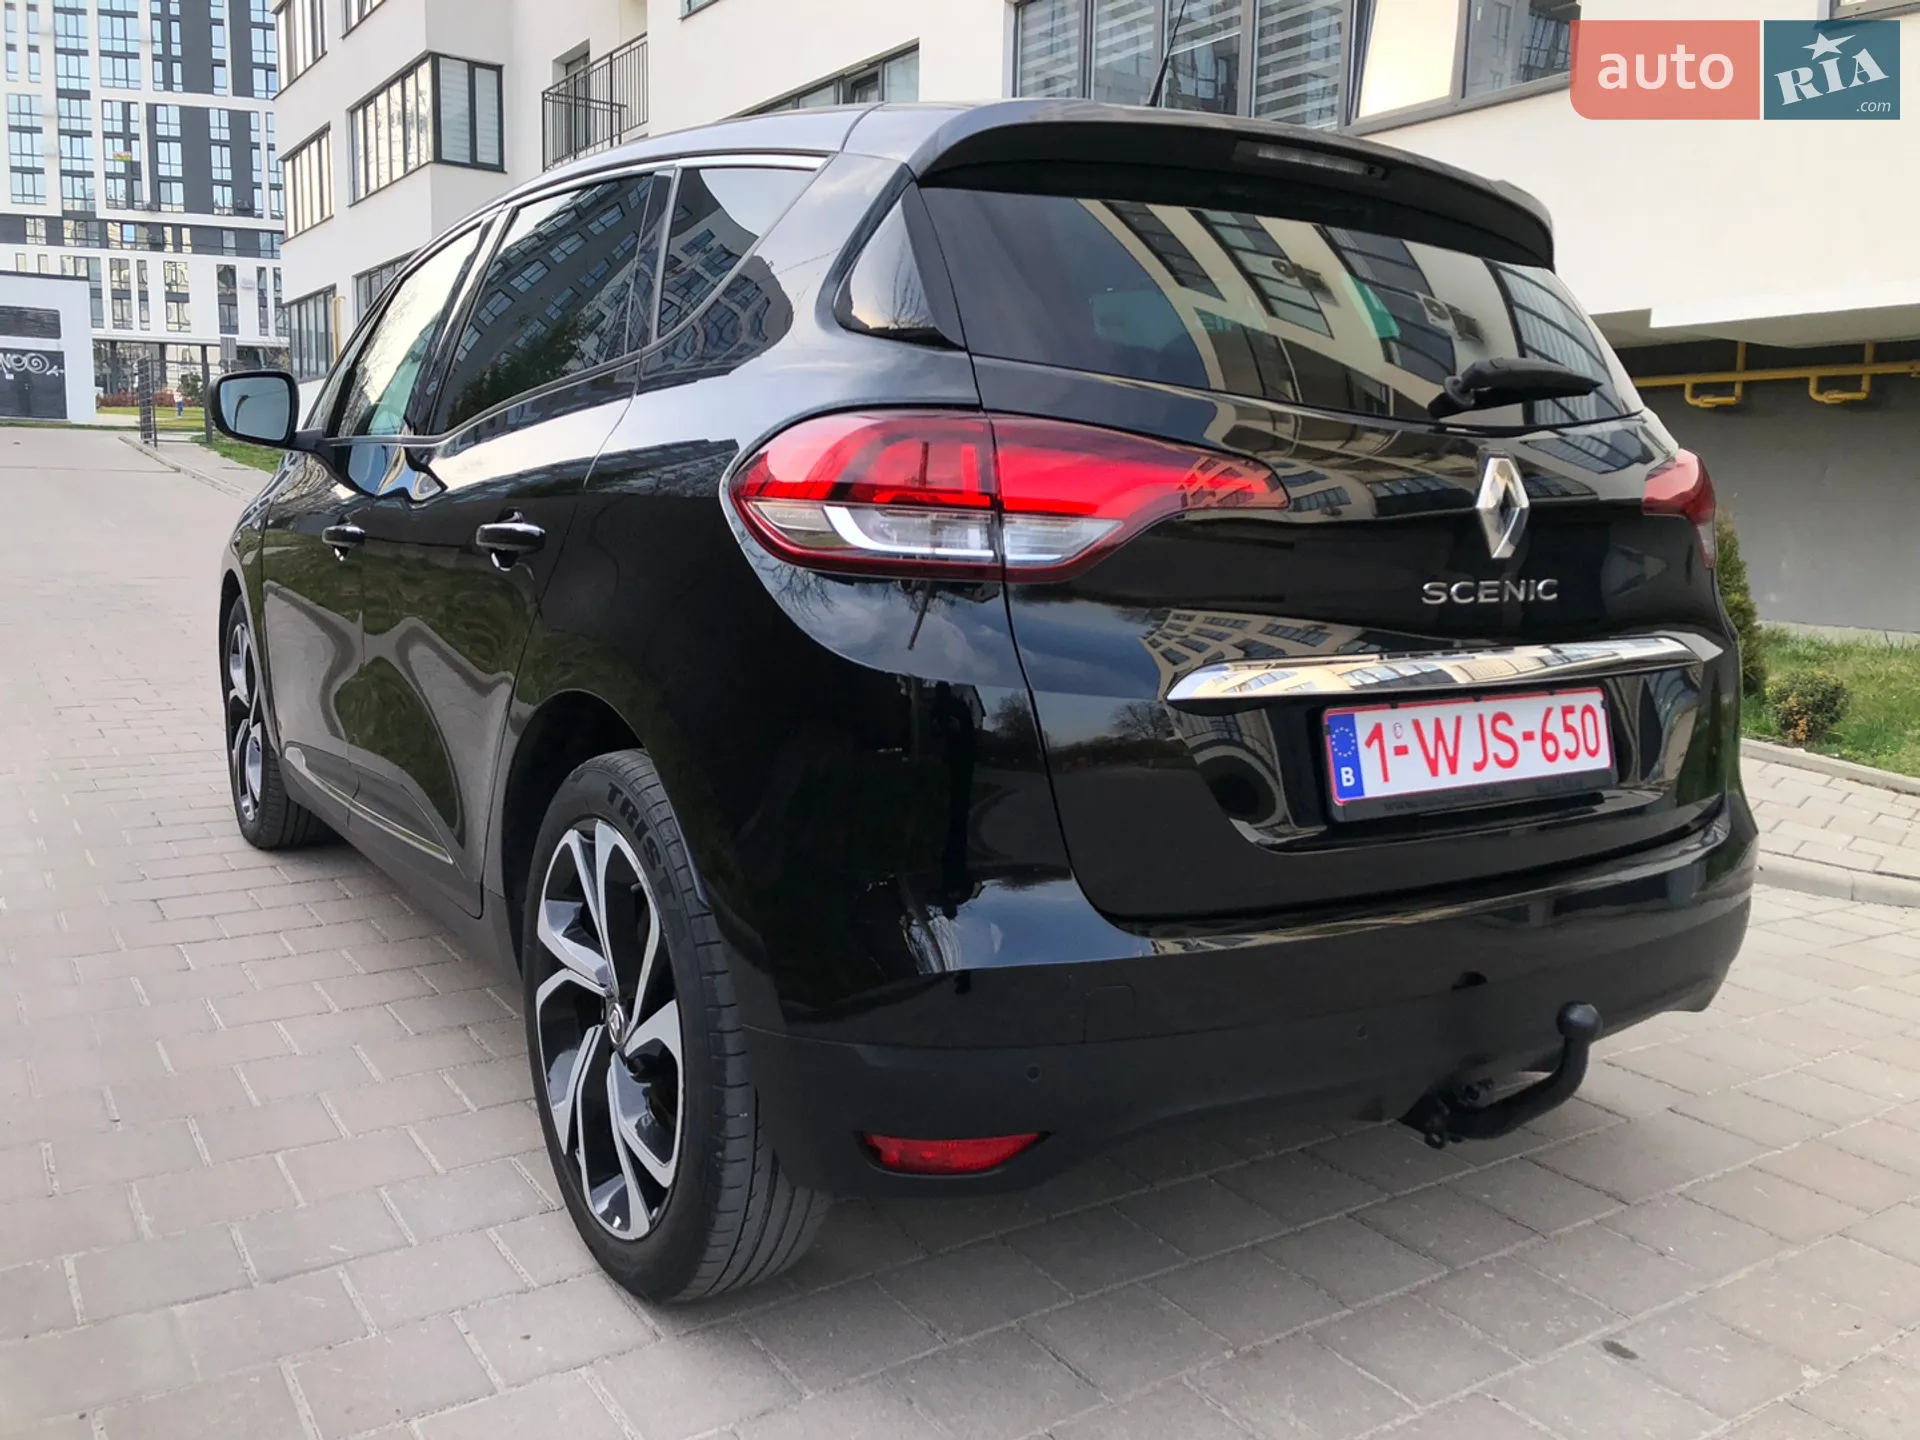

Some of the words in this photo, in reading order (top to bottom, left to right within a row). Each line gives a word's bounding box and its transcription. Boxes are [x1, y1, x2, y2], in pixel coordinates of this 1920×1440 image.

[1421, 578, 1559, 605] SCENIC
[1364, 703, 1601, 783] 1-WJS-650
[1341, 767, 1355, 787] B
